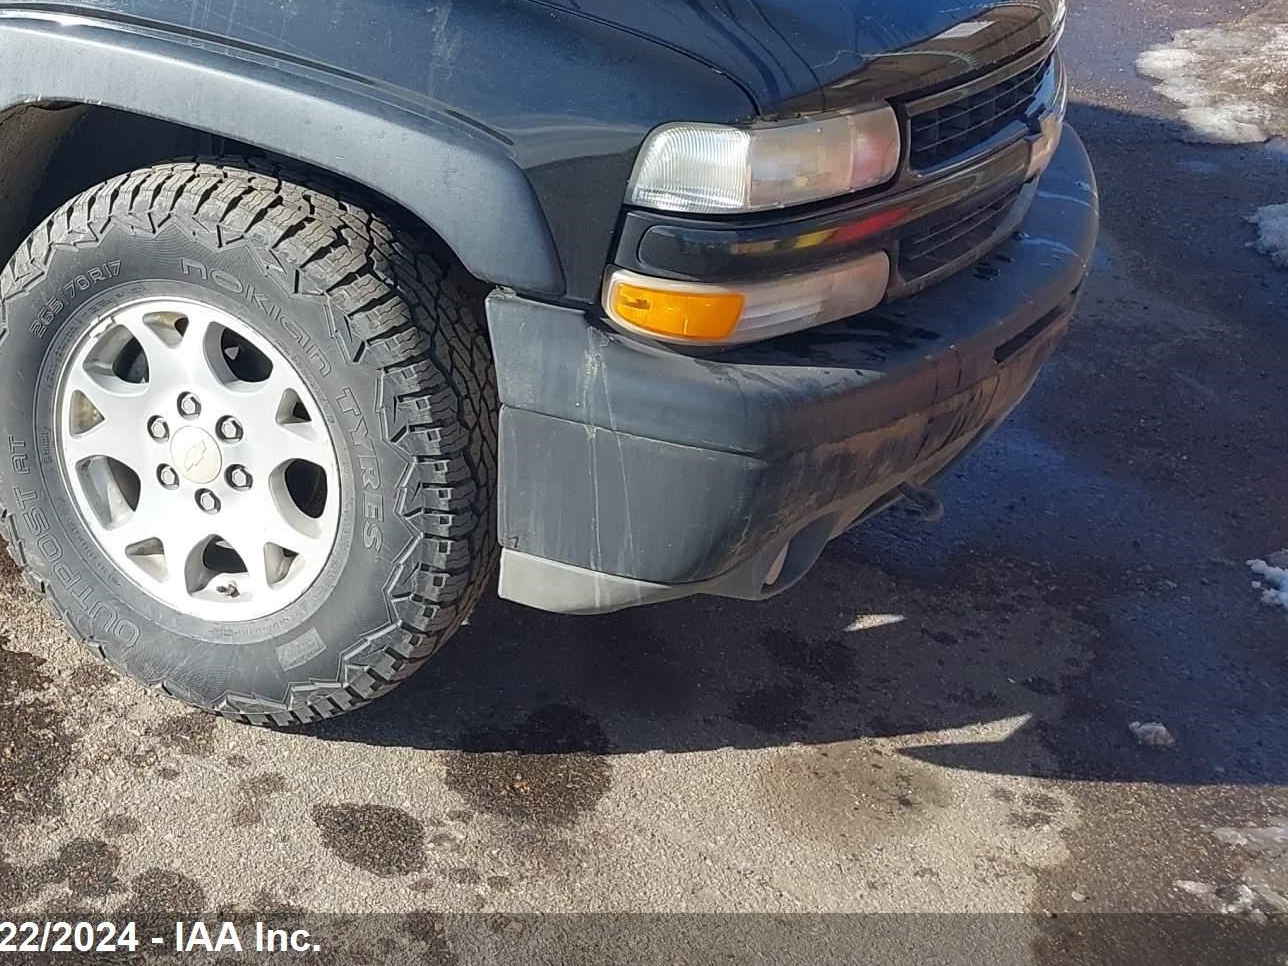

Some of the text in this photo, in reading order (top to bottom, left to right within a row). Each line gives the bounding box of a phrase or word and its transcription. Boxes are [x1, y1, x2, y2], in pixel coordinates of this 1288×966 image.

[29, 259, 122, 339] 265/70R17
[8, 434, 31, 475] AT
[335, 386, 385, 553] TYRES
[14, 485, 141, 650] OUTPOST
